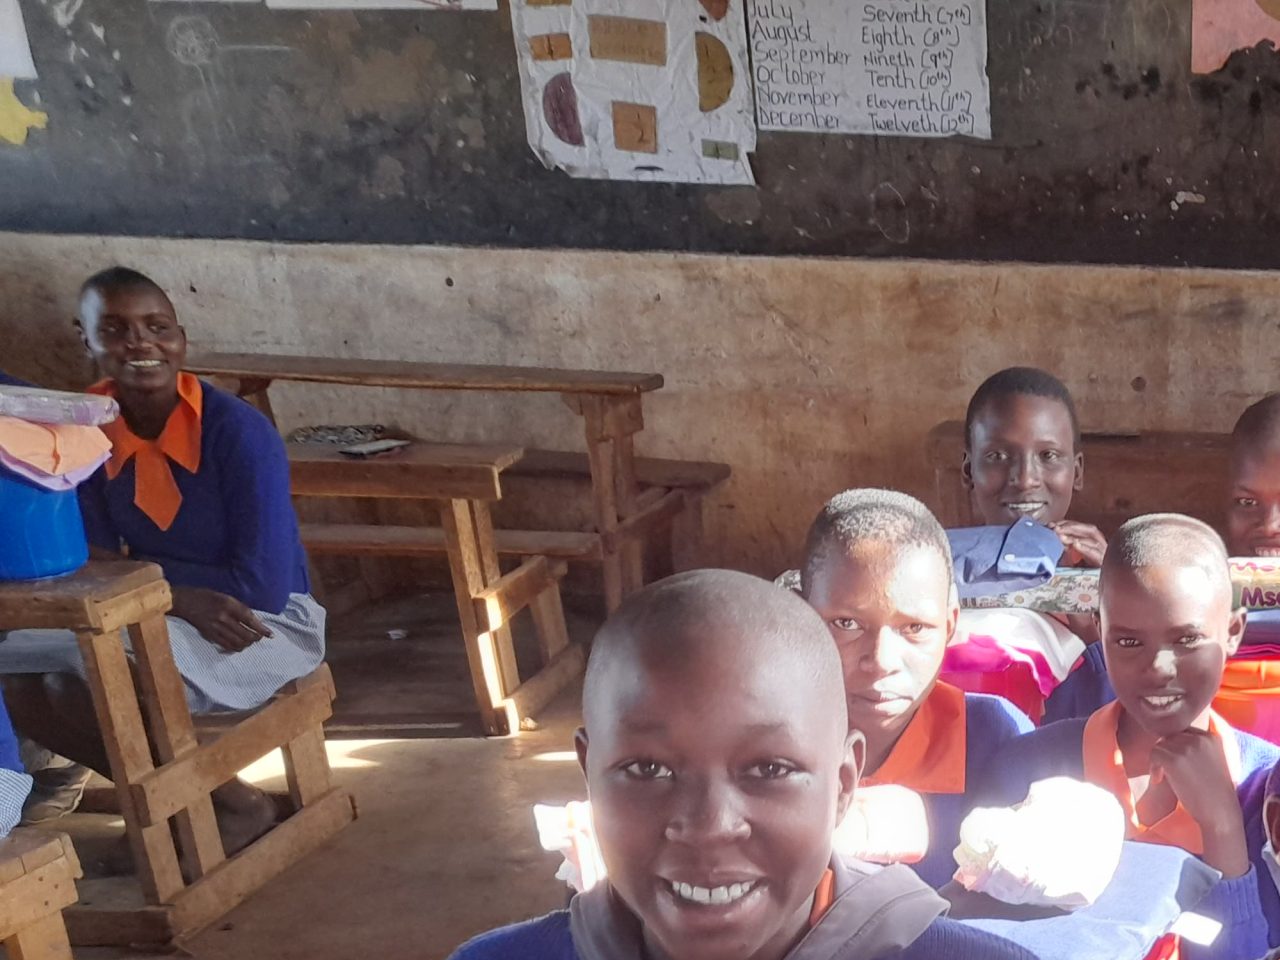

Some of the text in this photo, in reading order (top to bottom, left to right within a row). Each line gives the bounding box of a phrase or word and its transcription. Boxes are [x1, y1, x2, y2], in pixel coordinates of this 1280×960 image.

[863, 4, 932, 24] Seventh
[752, 20, 816, 45] August
[862, 25, 915, 53] Eighth
[755, 41, 851, 72] September
[863, 49, 914, 69] Nineth
[756, 64, 825, 86] October
[867, 69, 915, 89] Tenth
[758, 85, 841, 106] November
[866, 91, 939, 112] Eleventh
[759, 106, 841, 129] December
[870, 112, 938, 133] Twelveth
